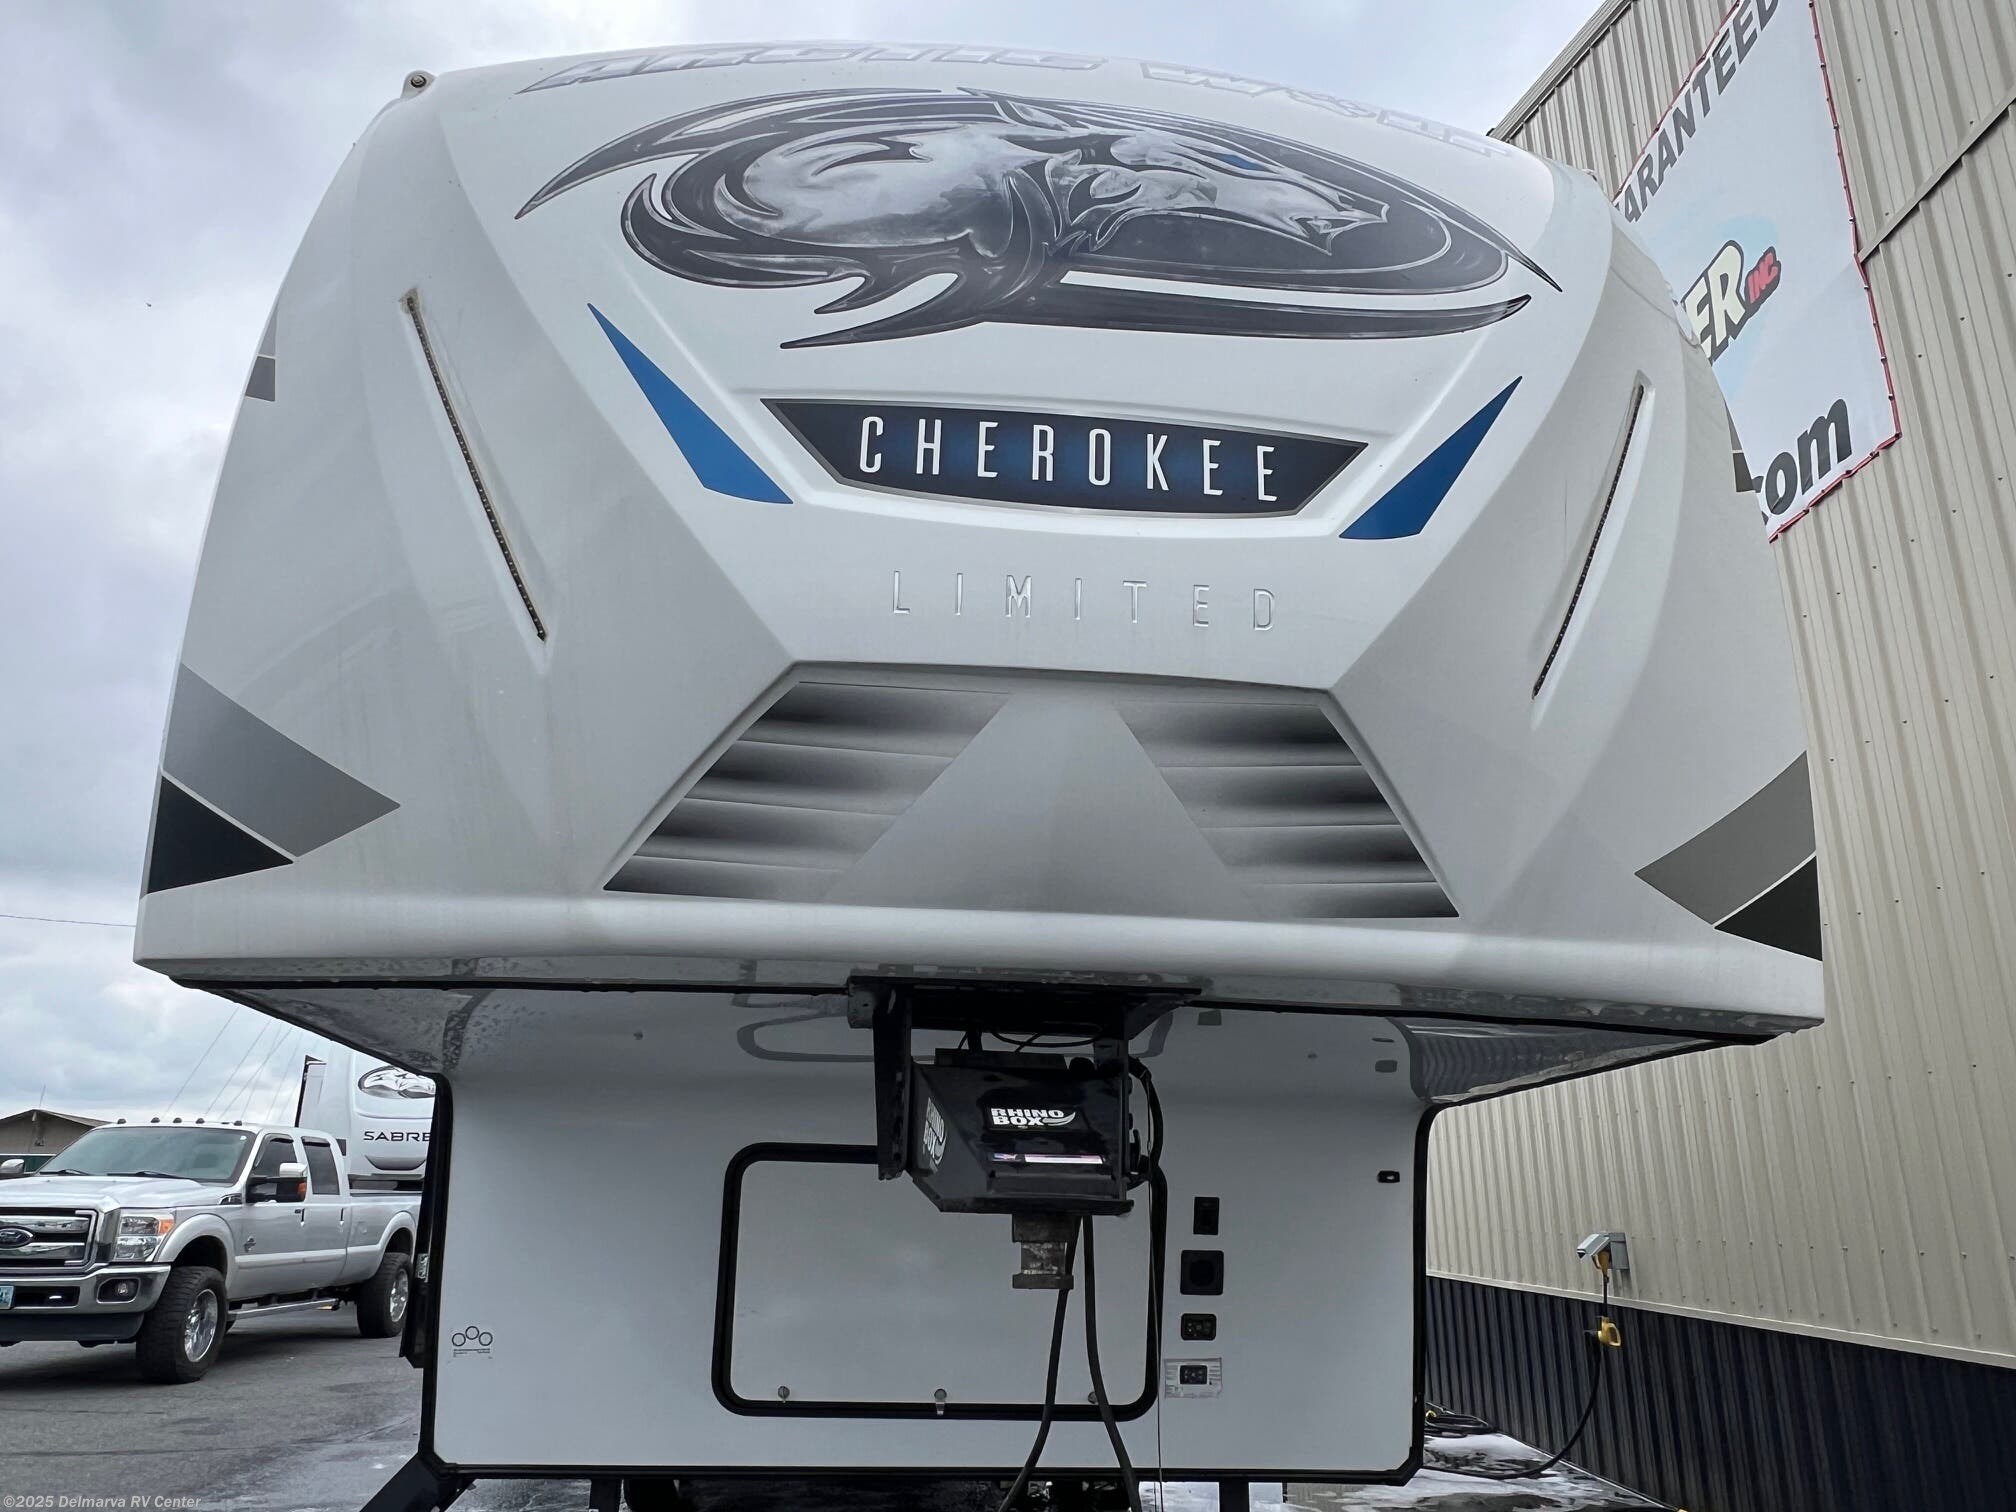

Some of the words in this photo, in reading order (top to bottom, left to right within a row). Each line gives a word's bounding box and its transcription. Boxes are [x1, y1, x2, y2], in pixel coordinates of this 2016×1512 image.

[1614, 0, 1780, 223] ARANTEED
[858, 415, 1279, 503] CHEROKEE
[892, 569, 1277, 632] LIMITED
[990, 1107, 1065, 1119] RHINO
[992, 1116, 1045, 1126] BOX
[363, 1130, 431, 1142] SABRE
